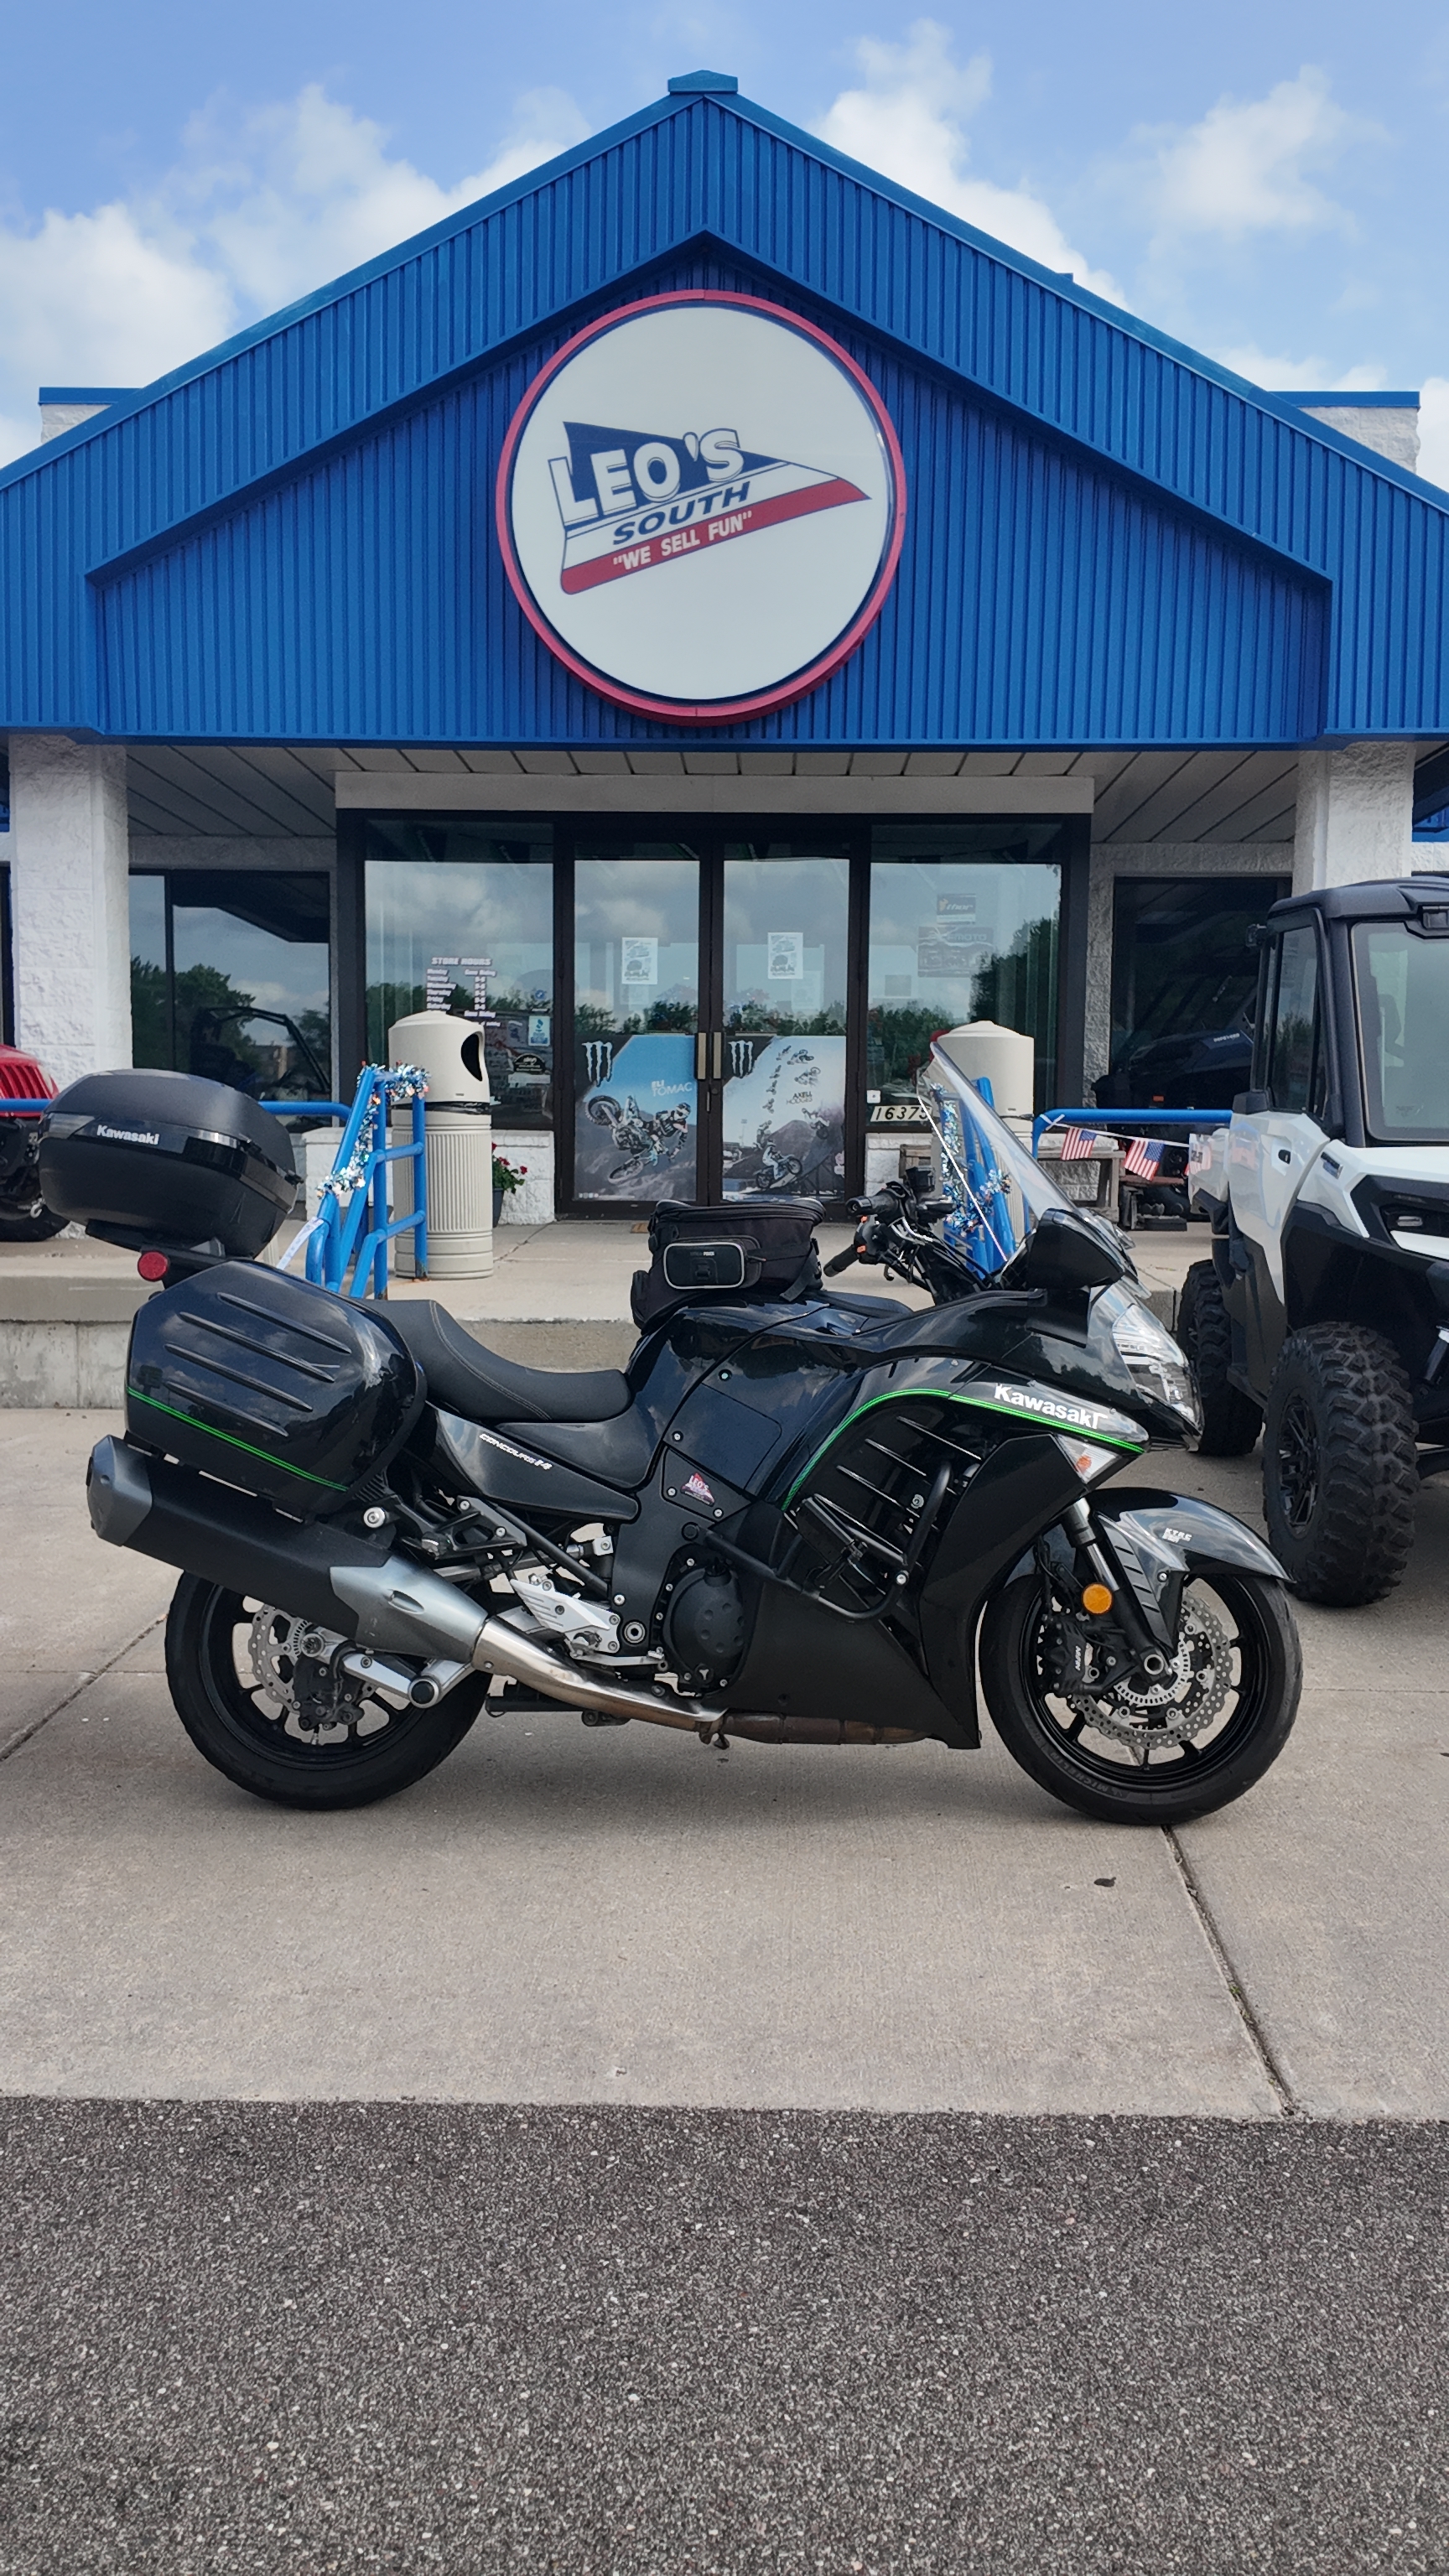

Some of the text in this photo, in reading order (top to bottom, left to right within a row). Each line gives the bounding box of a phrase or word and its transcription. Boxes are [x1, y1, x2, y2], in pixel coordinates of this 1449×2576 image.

[548, 428, 745, 527] LEO'S
[612, 480, 750, 545] SOUTH
[612, 510, 753, 570] "WE SELL FUN"
[431, 957, 492, 966] STORE HOURS
[652, 1082, 693, 1097] TOMAC
[96, 1124, 160, 1145] Kawasaki
[994, 1383, 1108, 1430] Kawasaki
